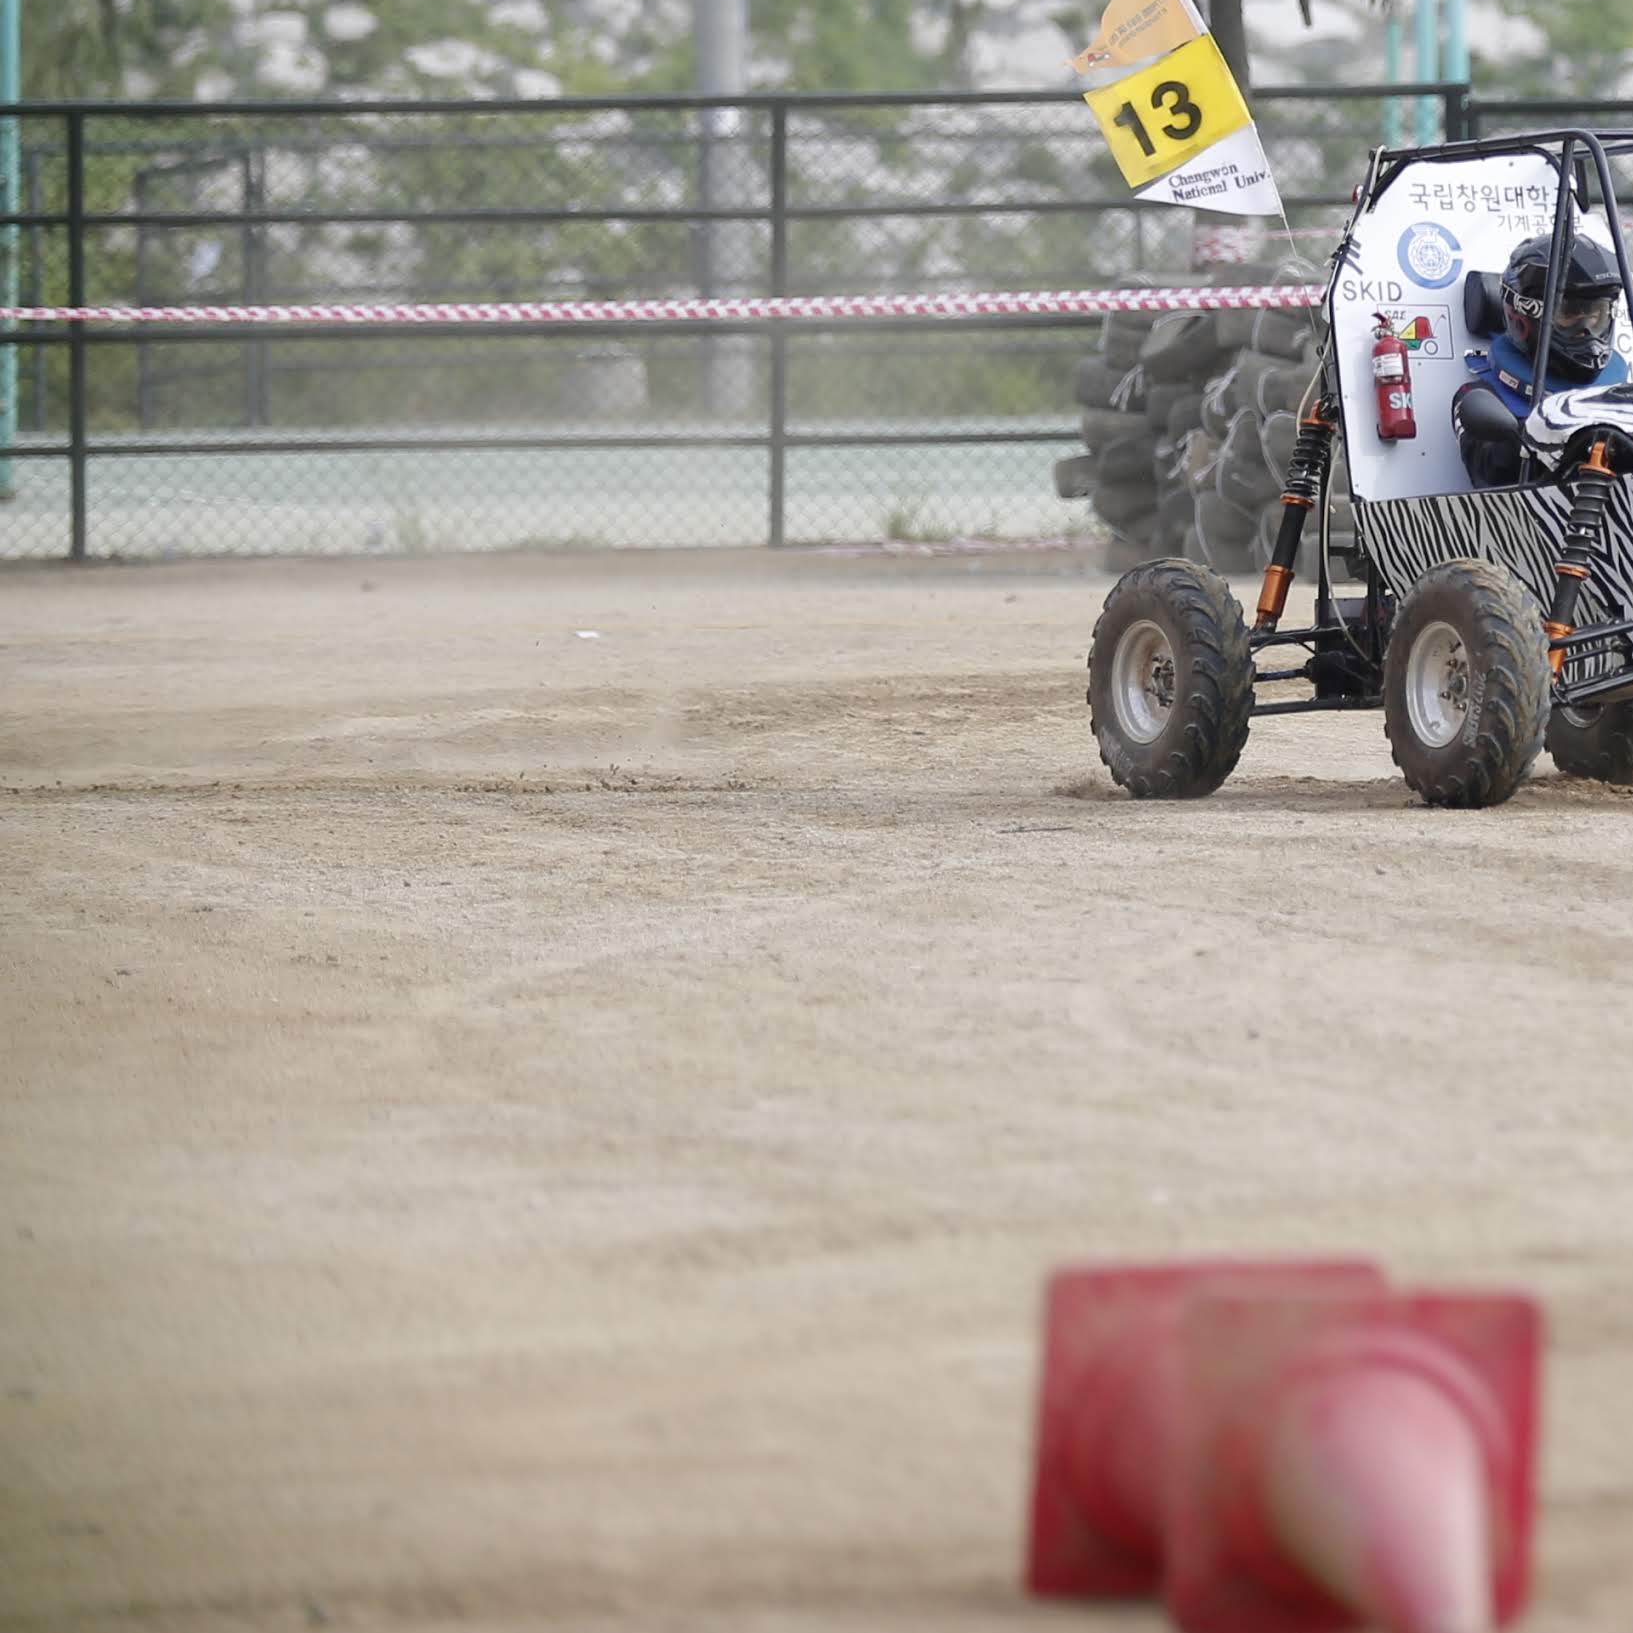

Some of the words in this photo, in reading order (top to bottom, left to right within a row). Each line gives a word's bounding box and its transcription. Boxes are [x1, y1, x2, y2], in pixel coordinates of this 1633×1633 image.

[1113, 80, 1203, 157] 13
[1168, 164, 1238, 188] Changwon
[1234, 171, 1271, 189] Univ.
[1408, 182, 1558, 214] 국립창원대학
[1497, 214, 1584, 236] 기계공부
[1343, 280, 1402, 302] SKID
